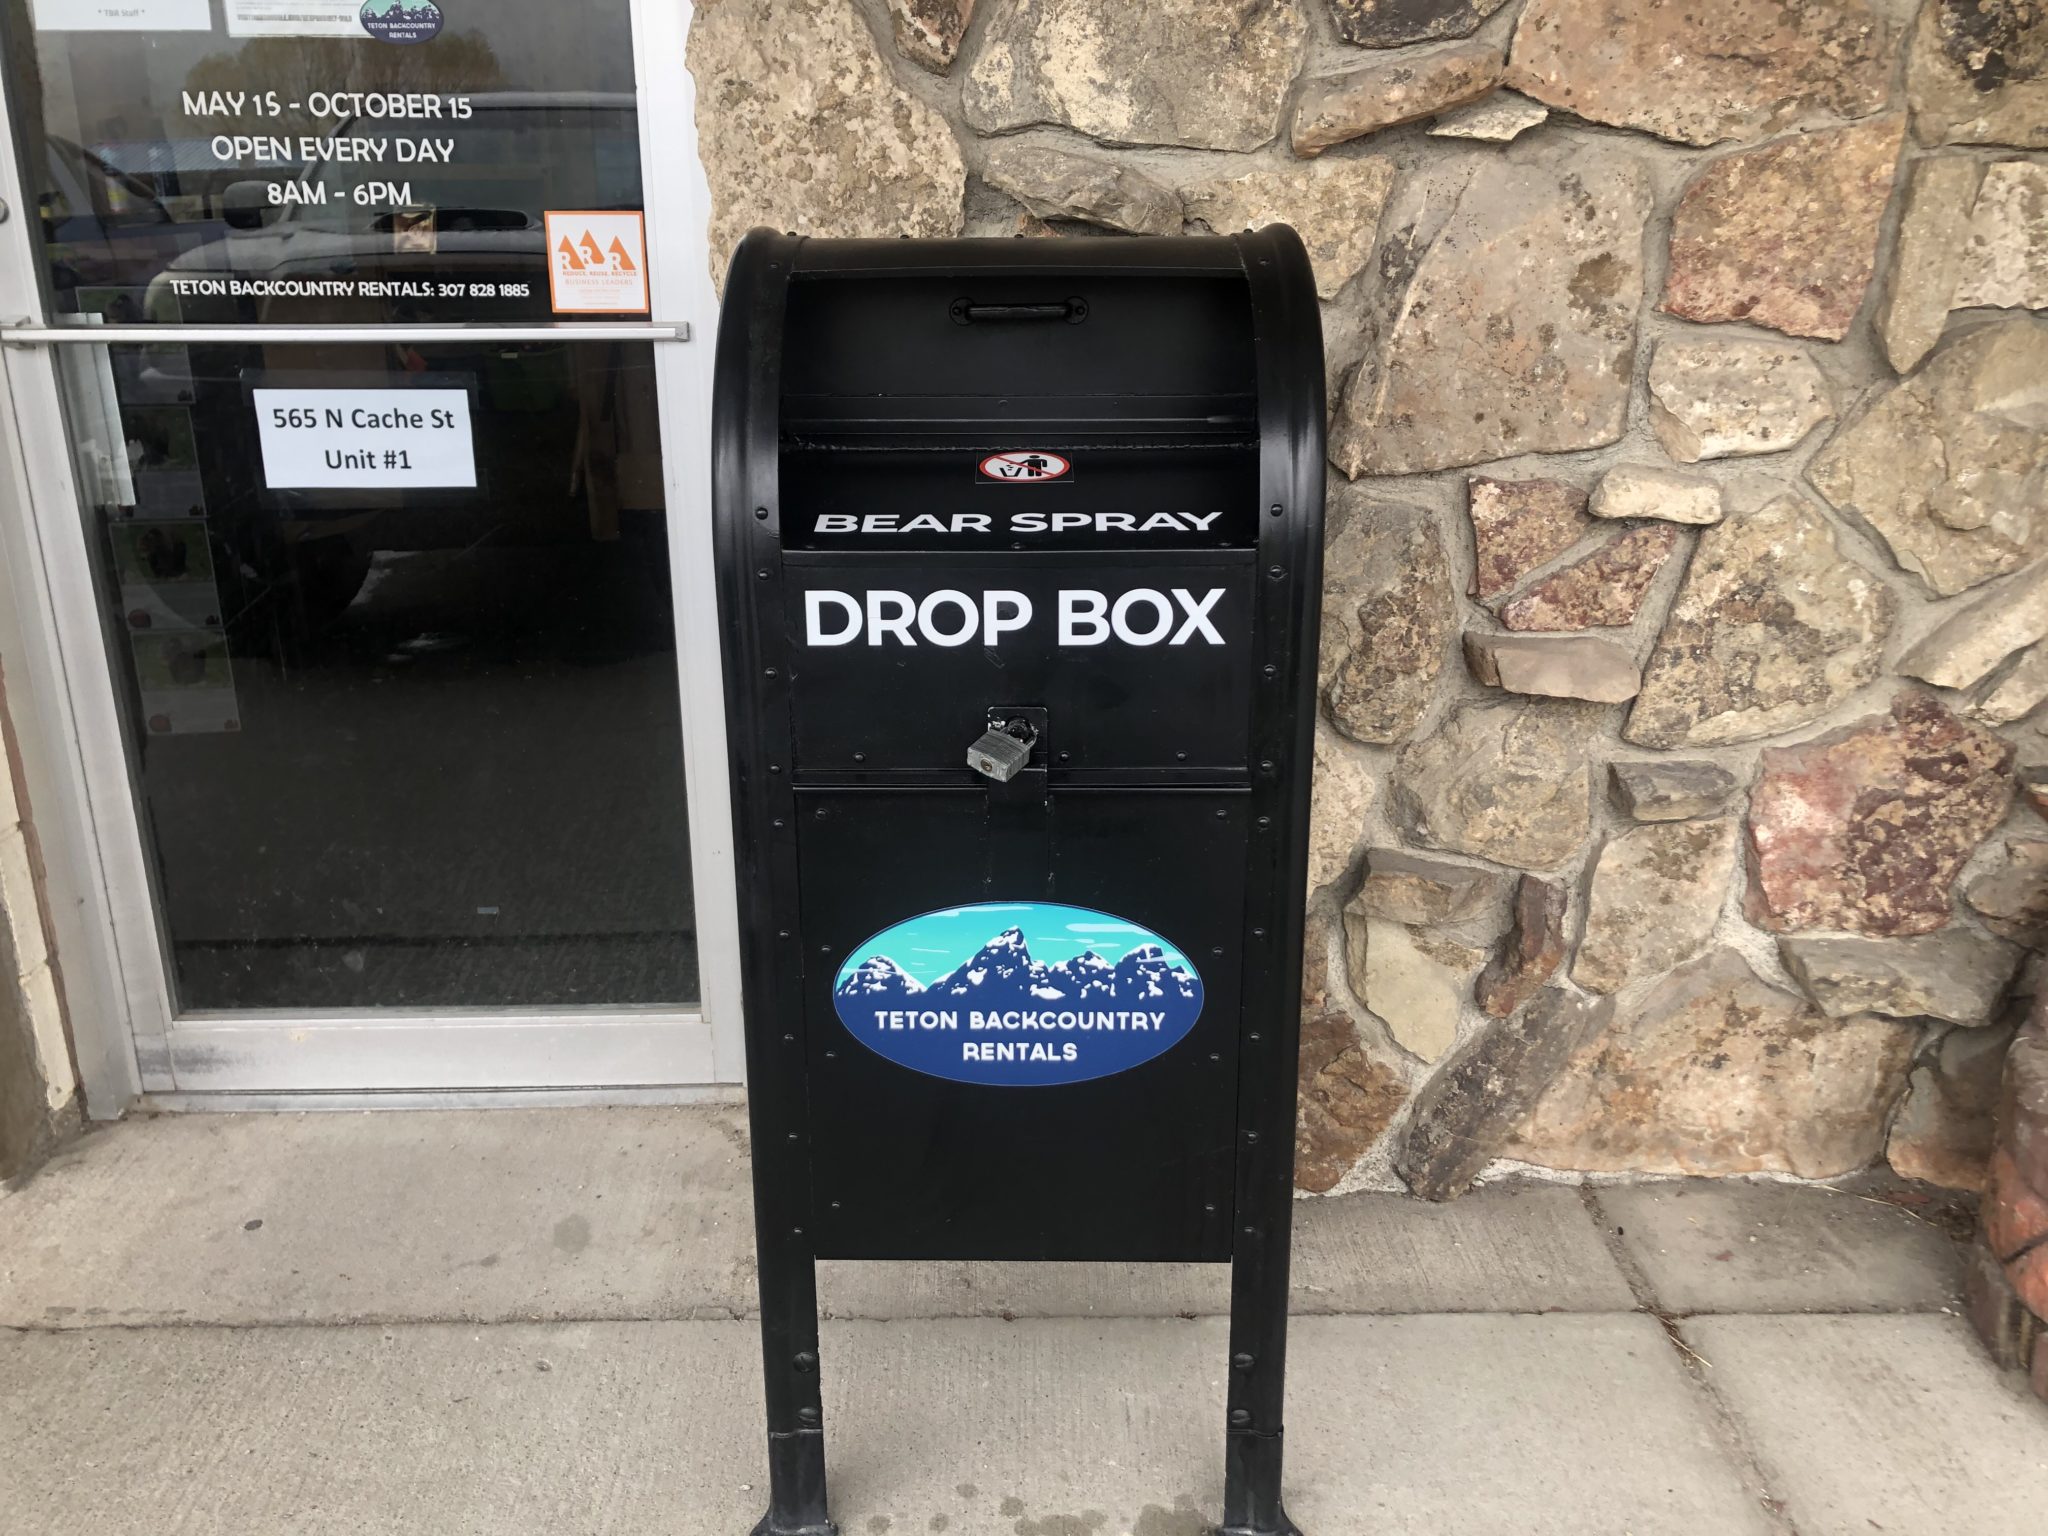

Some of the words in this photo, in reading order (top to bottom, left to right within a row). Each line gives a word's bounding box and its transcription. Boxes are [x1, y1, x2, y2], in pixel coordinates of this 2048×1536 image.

[388, 31, 417, 39] RENTALS
[182, 90, 245, 116] MAY
[308, 91, 443, 118] OCTOBER
[448, 97, 473, 119] 15
[211, 135, 292, 161] OPEN
[299, 136, 388, 162] EVERY
[395, 138, 455, 163] DAY
[267, 180, 327, 205] 8AM
[353, 181, 412, 206] 6PM
[169, 279, 227, 296] TETON
[229, 280, 355, 296] BACKCOUNTRY
[358, 281, 435, 297] RENTALS:
[438, 283, 466, 297] 307
[469, 283, 496, 297] 828
[498, 283, 530, 297] 1885
[273, 408, 317, 429] 565
[325, 408, 343, 428] N
[351, 407, 423, 429] Cache
[430, 408, 455, 429] St
[325, 449, 377, 470] Unit
[383, 450, 412, 470] #1
[813, 513, 992, 533] BEAR
[1009, 511, 1223, 533] SPRAY
[804, 589, 1033, 647] DROP
[1058, 588, 1227, 647] BOX
[874, 1010, 958, 1030] TETON
[969, 1010, 1166, 1031] BACKCOUNTRY
[962, 1042, 1078, 1062] RENTALS
